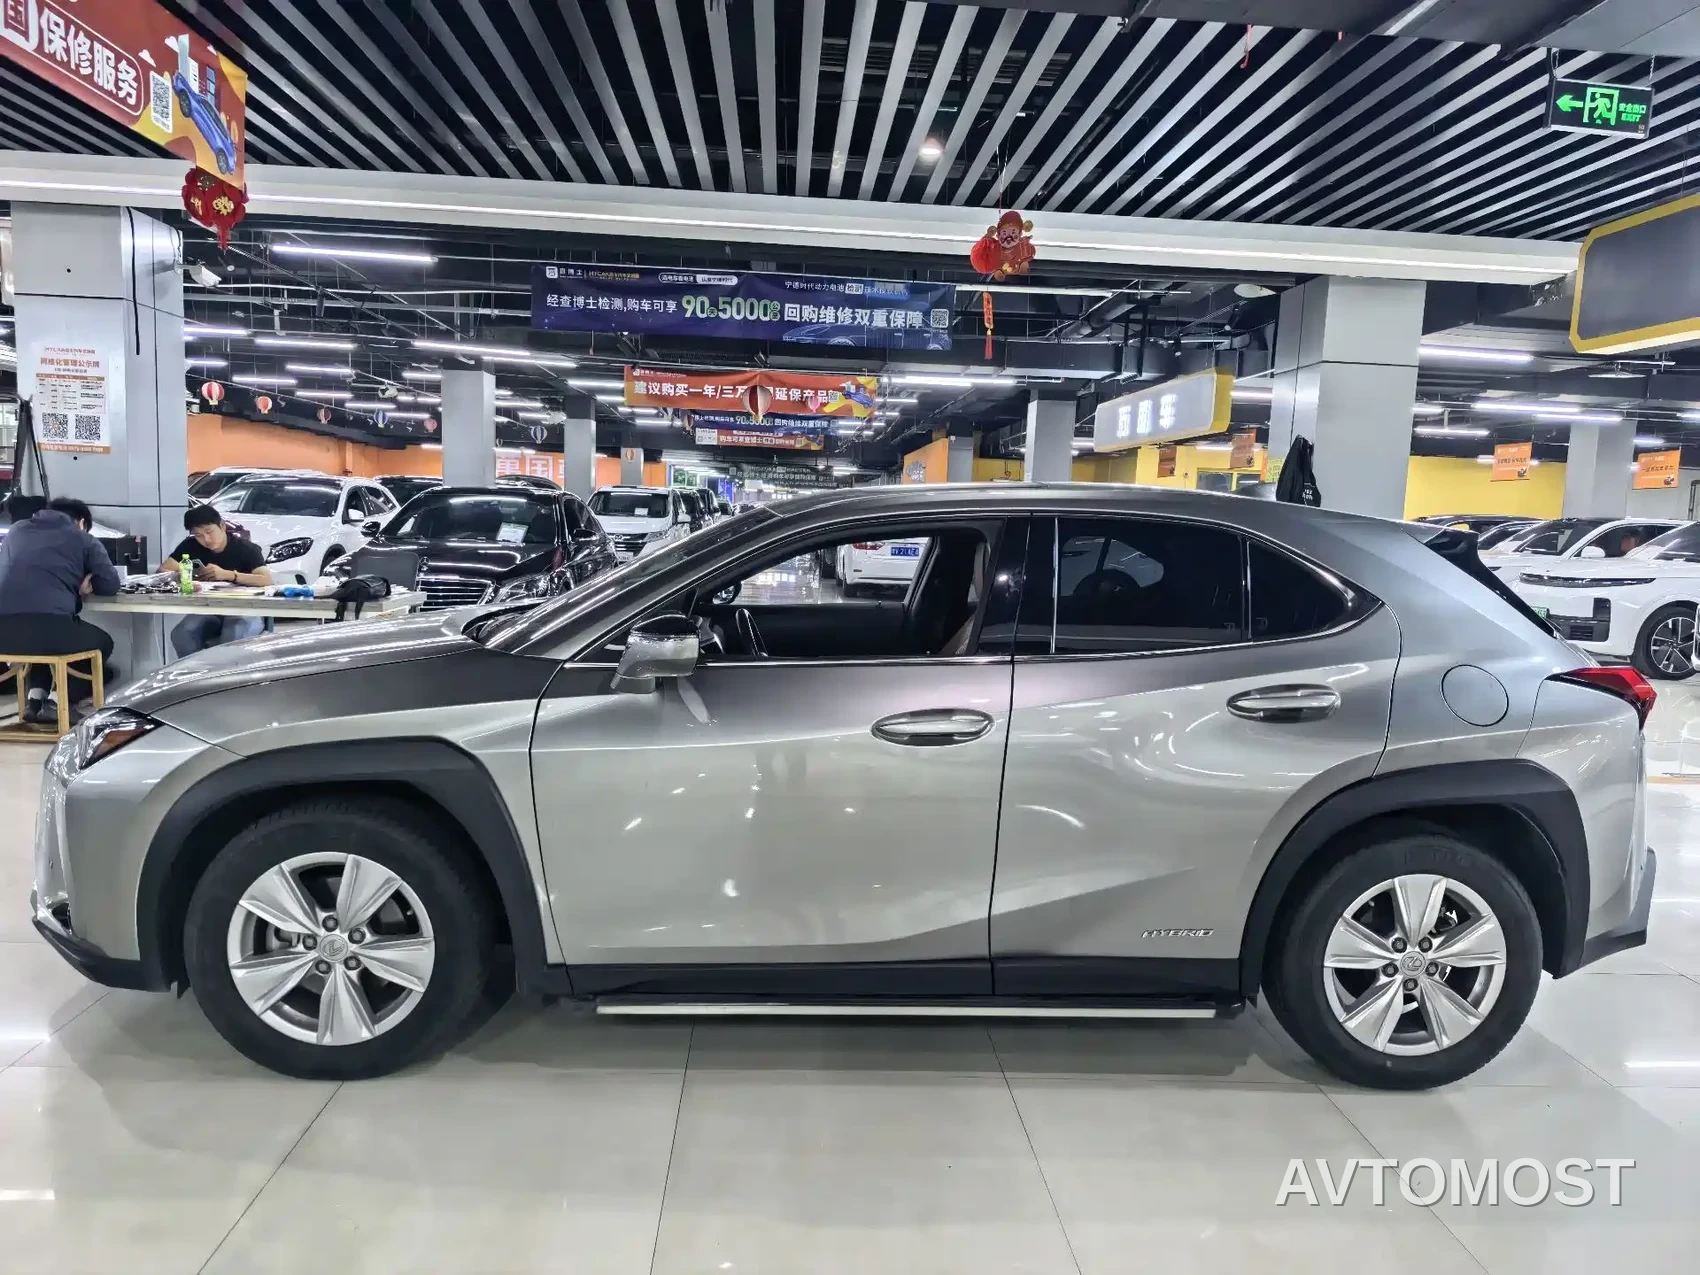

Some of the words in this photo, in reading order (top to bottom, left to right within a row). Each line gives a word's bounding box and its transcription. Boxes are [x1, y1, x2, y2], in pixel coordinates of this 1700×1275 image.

[40, 6, 138, 106] 保修服务
[1618, 103, 1647, 114] 安全出口
[1620, 113, 1642, 123] EXIT
[784, 303, 924, 329] 回购维修双重保障
[634, 380, 829, 403] 建议购买一年/三万延保产品
[1141, 928, 1214, 939] HYBRID
